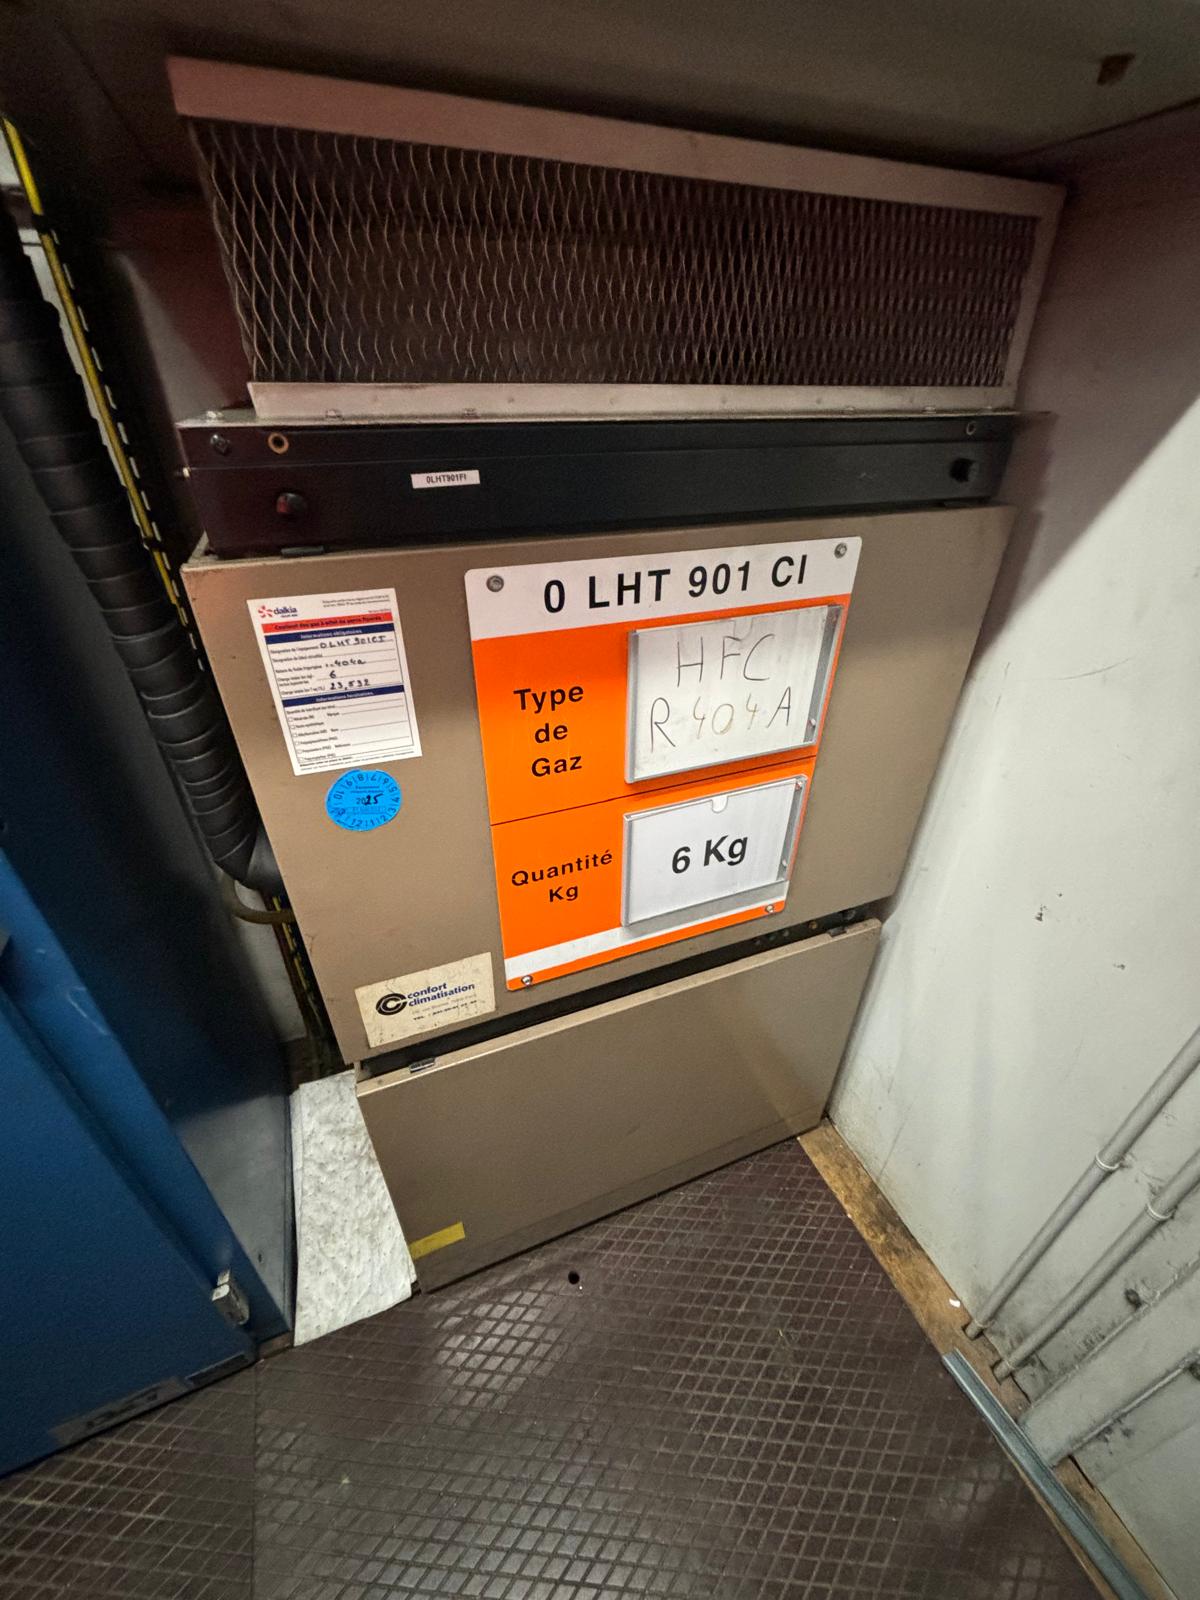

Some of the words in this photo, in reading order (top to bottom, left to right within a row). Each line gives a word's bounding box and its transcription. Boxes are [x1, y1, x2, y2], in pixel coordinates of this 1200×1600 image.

[588, 568, 671, 609] LHT
[688, 561, 751, 598] 901
[771, 554, 808, 587] CI
[273, 606, 297, 615] dalkia
[676, 633, 776, 688] HFC
[329, 670, 336, 679] 6
[513, 685, 585, 715] Type
[534, 722, 568, 744] de
[531, 753, 583, 777] Gaz
[672, 846, 691, 874] 6
[703, 835, 748, 867] Kg
[511, 850, 613, 887] Quantité
[549, 885, 579, 902] Kg
[407, 982, 447, 999] confort
[408, 983, 475, 1007] climatisation
